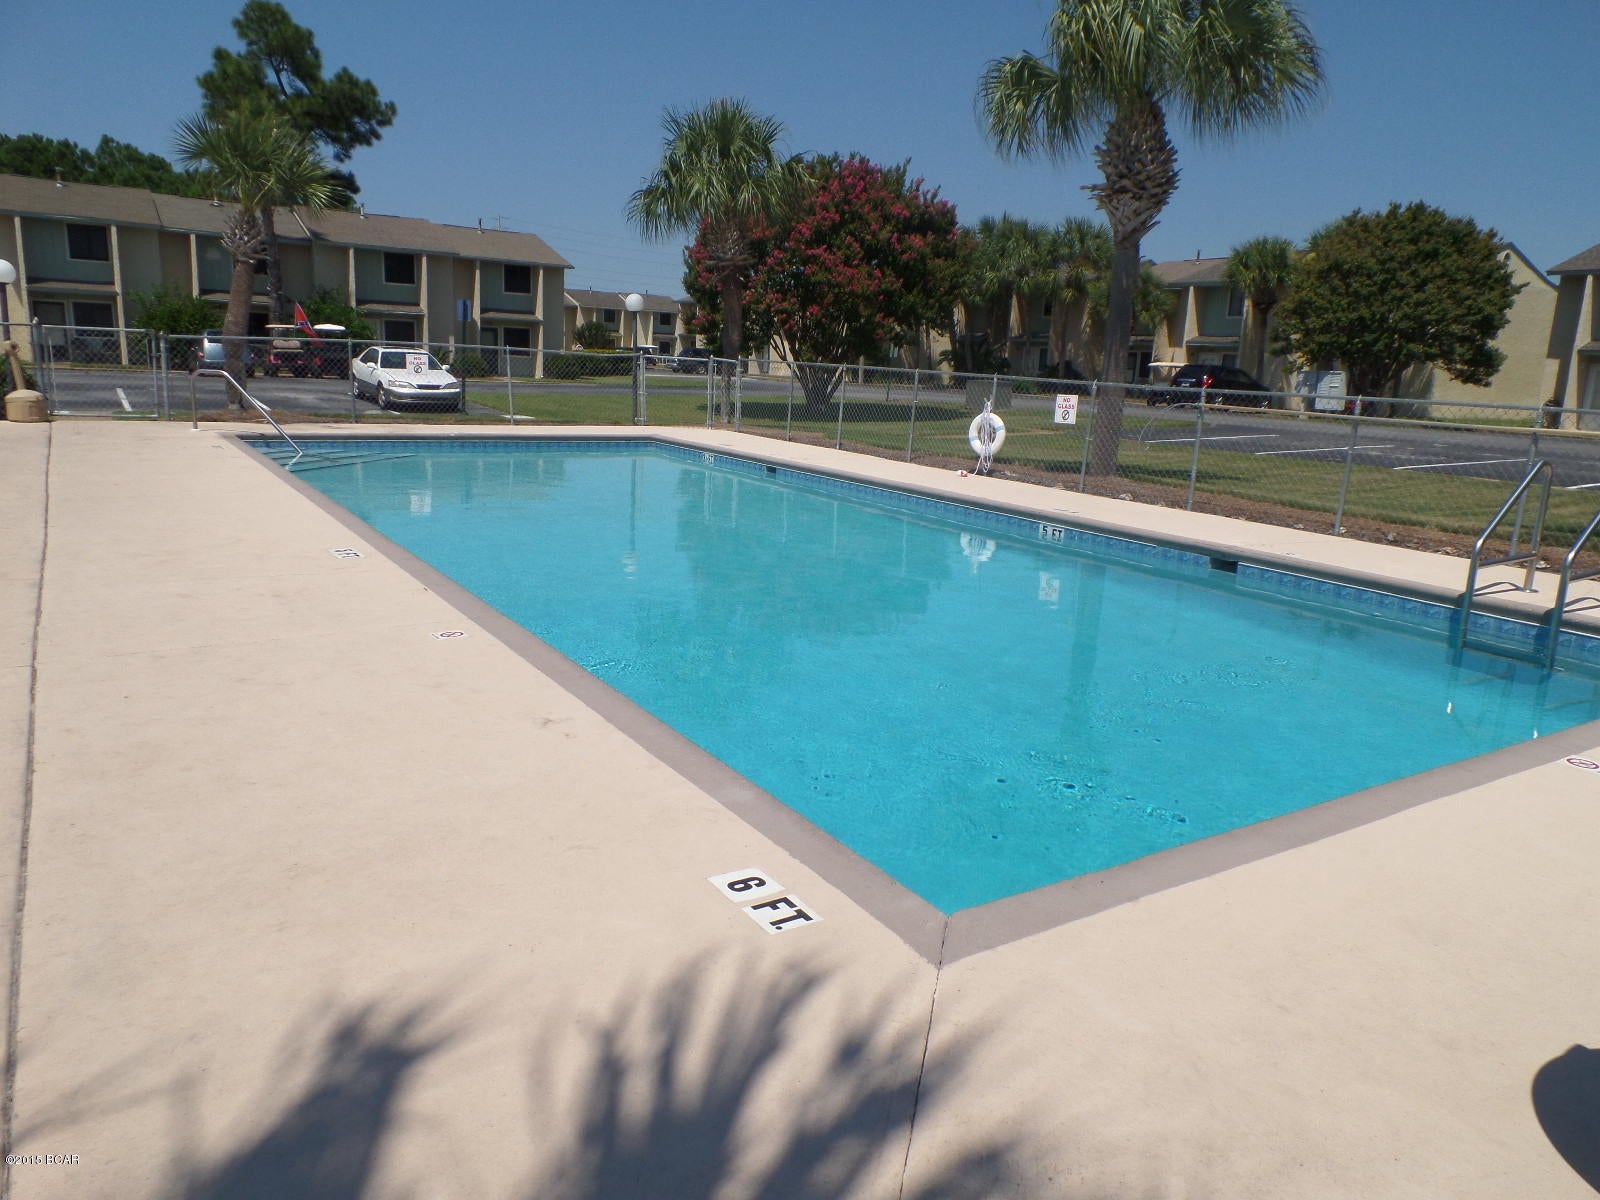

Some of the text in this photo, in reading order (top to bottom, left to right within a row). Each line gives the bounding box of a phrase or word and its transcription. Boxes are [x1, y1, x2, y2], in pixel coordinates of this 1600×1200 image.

[1052, 528, 1063, 540] FT
[726, 876, 815, 931] 6 FT.
